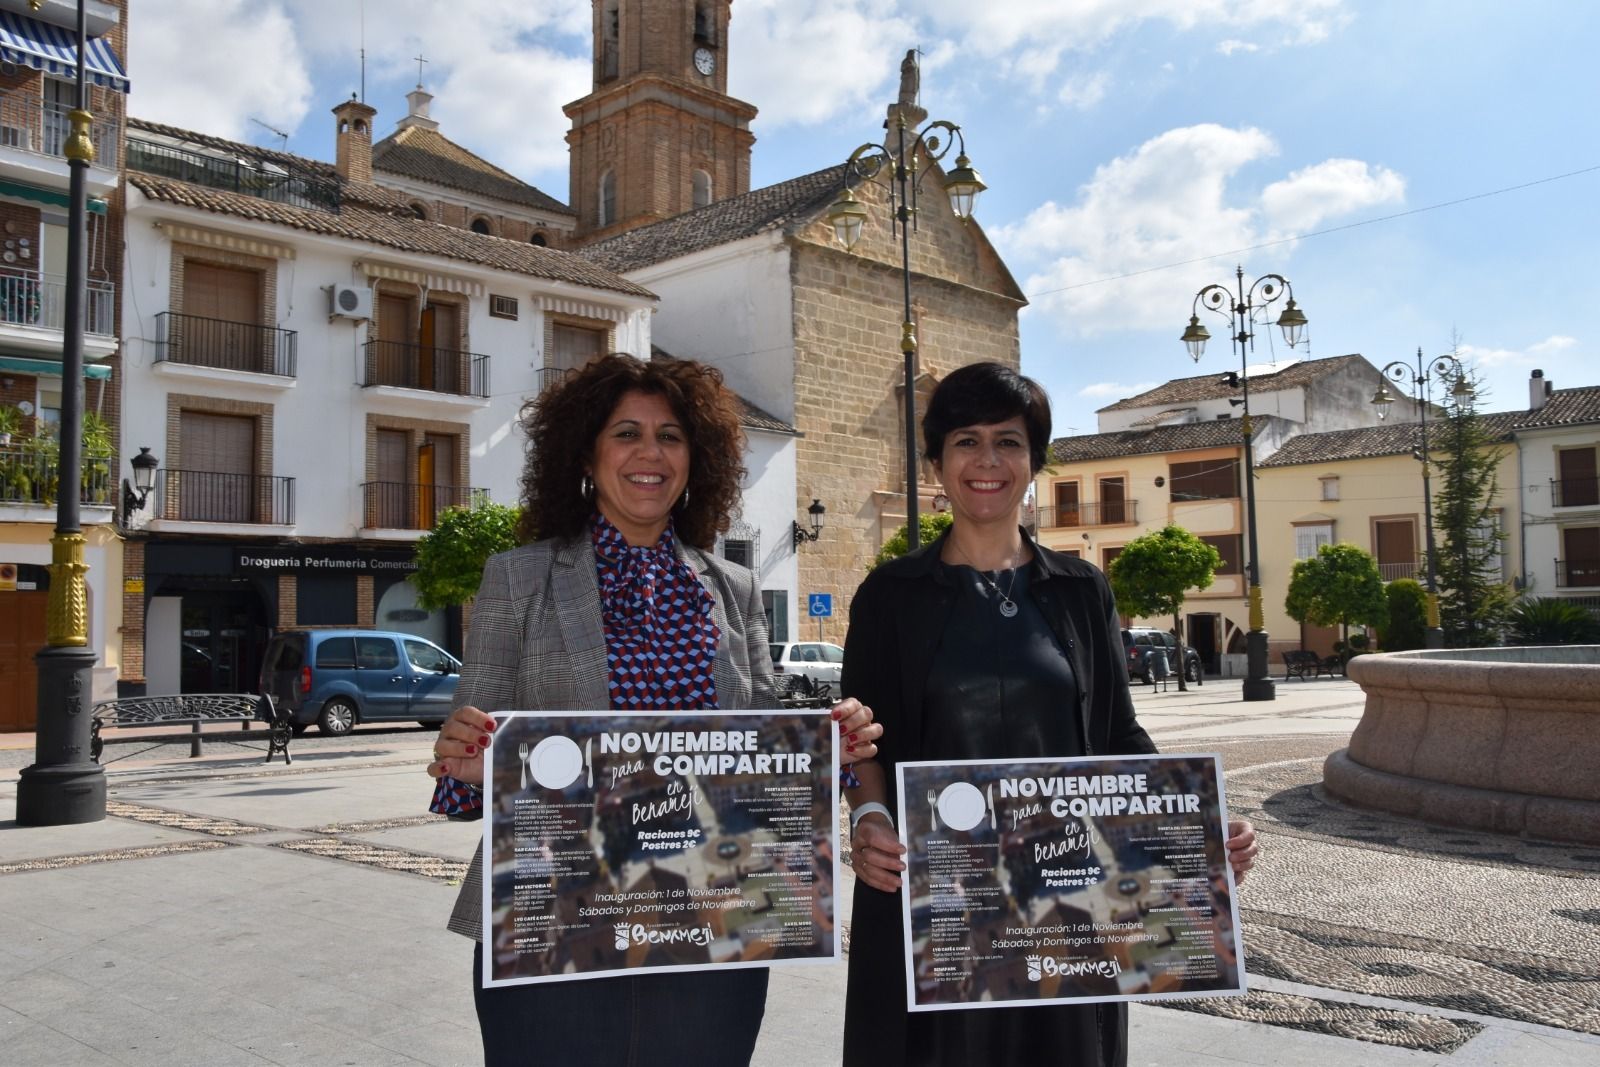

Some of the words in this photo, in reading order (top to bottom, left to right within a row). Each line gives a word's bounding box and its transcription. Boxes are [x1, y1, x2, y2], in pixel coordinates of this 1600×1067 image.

[600, 731, 758, 754] NOVIEMBRE
[653, 753, 812, 776] COMPARTIR
[1000, 774, 1148, 798] NOVIEMBRE
[1050, 794, 1200, 818] COMPARTIR
[638, 830, 685, 840] Raciones
[687, 829, 701, 838] 9€
[642, 842, 683, 850] Postres
[685, 840, 697, 849] 2€
[1042, 868, 1086, 877] Raciones
[1088, 866, 1100, 875] 9€
[1046, 878, 1082, 887] Postres
[1084, 877, 1098, 885] 2€
[594, 889, 664, 904] Inauguración:
[672, 888, 684, 898] de
[686, 886, 740, 897] Noviembre
[578, 904, 624, 917] Sábados
[626, 908, 632, 916] y
[634, 902, 684, 914] Domingos
[686, 901, 700, 910] de
[702, 898, 756, 910] Noviembre
[1006, 924, 1070, 937] Inauguración:
[1078, 924, 1090, 932] de
[1092, 922, 1144, 932] Noviembre
[992, 936, 1034, 948] Sábados
[1036, 940, 1042, 948] y
[1044, 936, 1091, 948] Domingos
[1094, 934, 1105, 944] de
[1108, 932, 1159, 943] Noviembre
